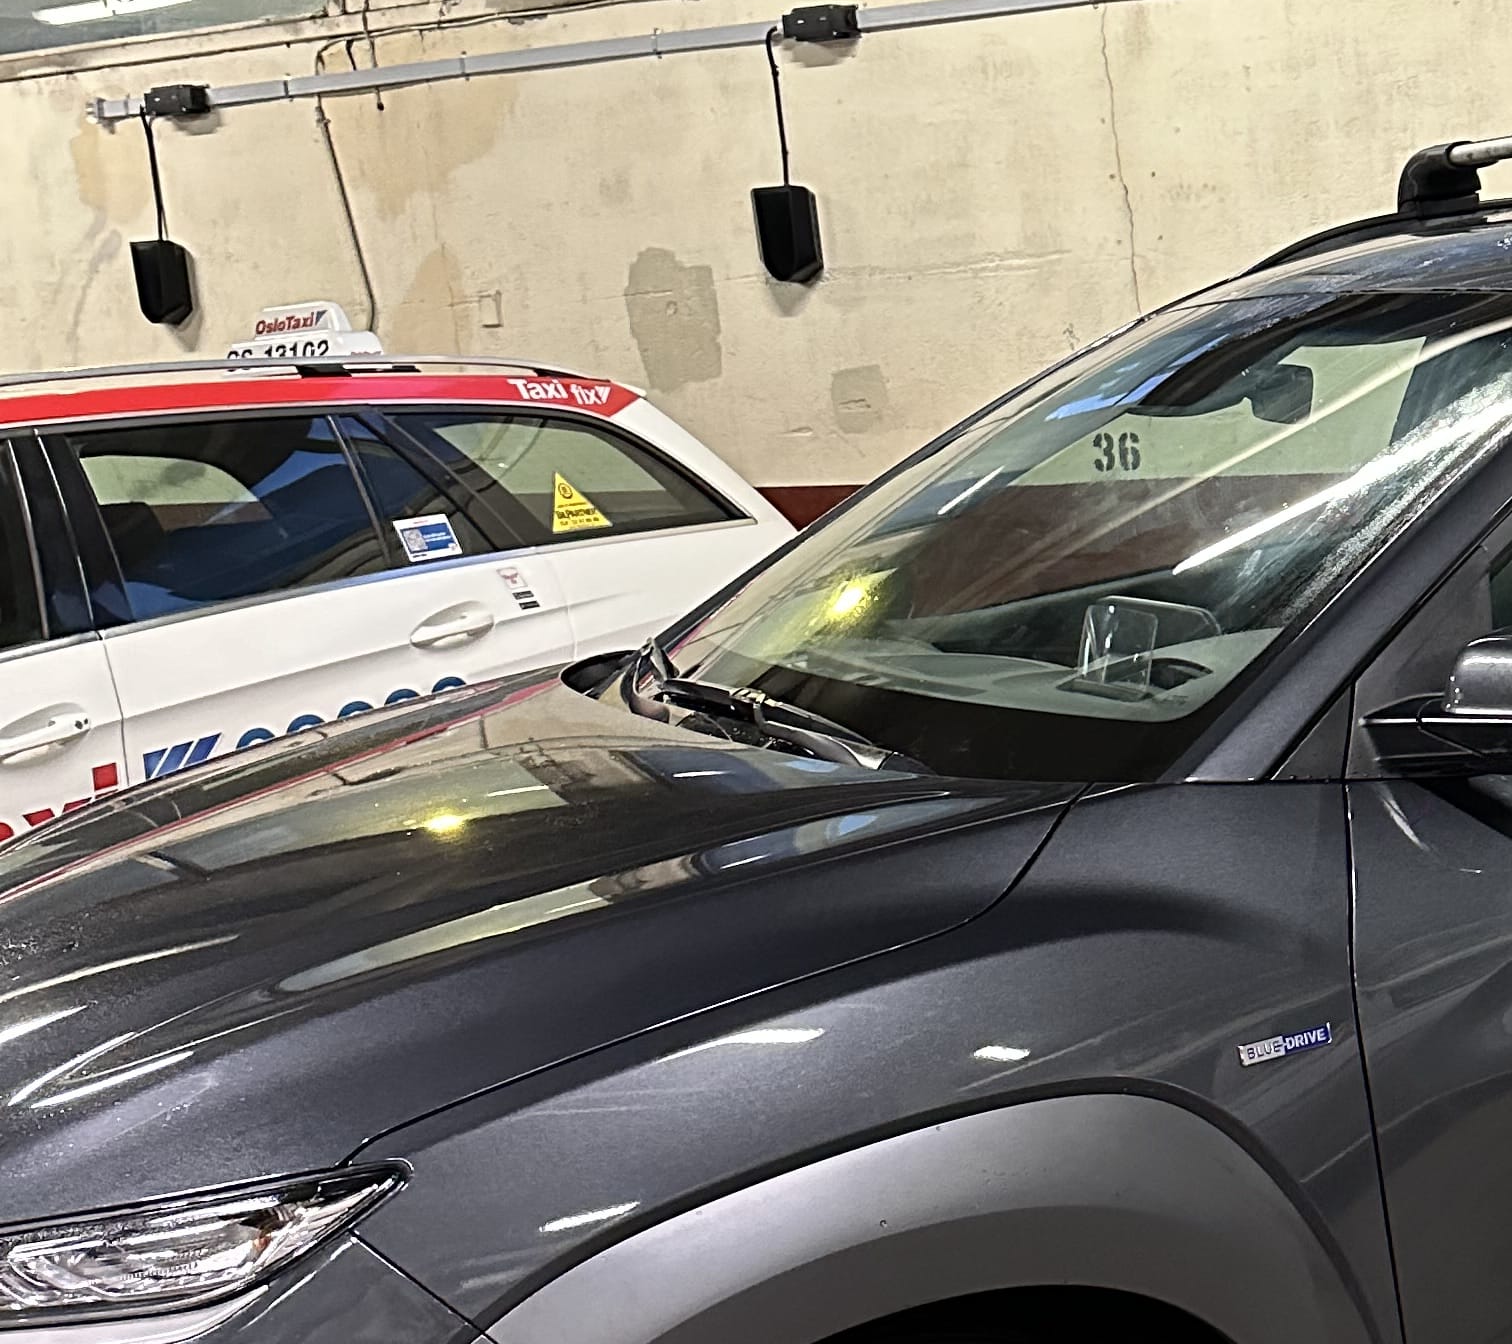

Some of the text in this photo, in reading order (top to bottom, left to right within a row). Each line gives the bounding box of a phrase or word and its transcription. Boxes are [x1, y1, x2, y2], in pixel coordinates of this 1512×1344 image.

[255, 311, 316, 336] OsloTaxi
[506, 378, 569, 401] Taxi
[1092, 431, 1141, 473] 36
